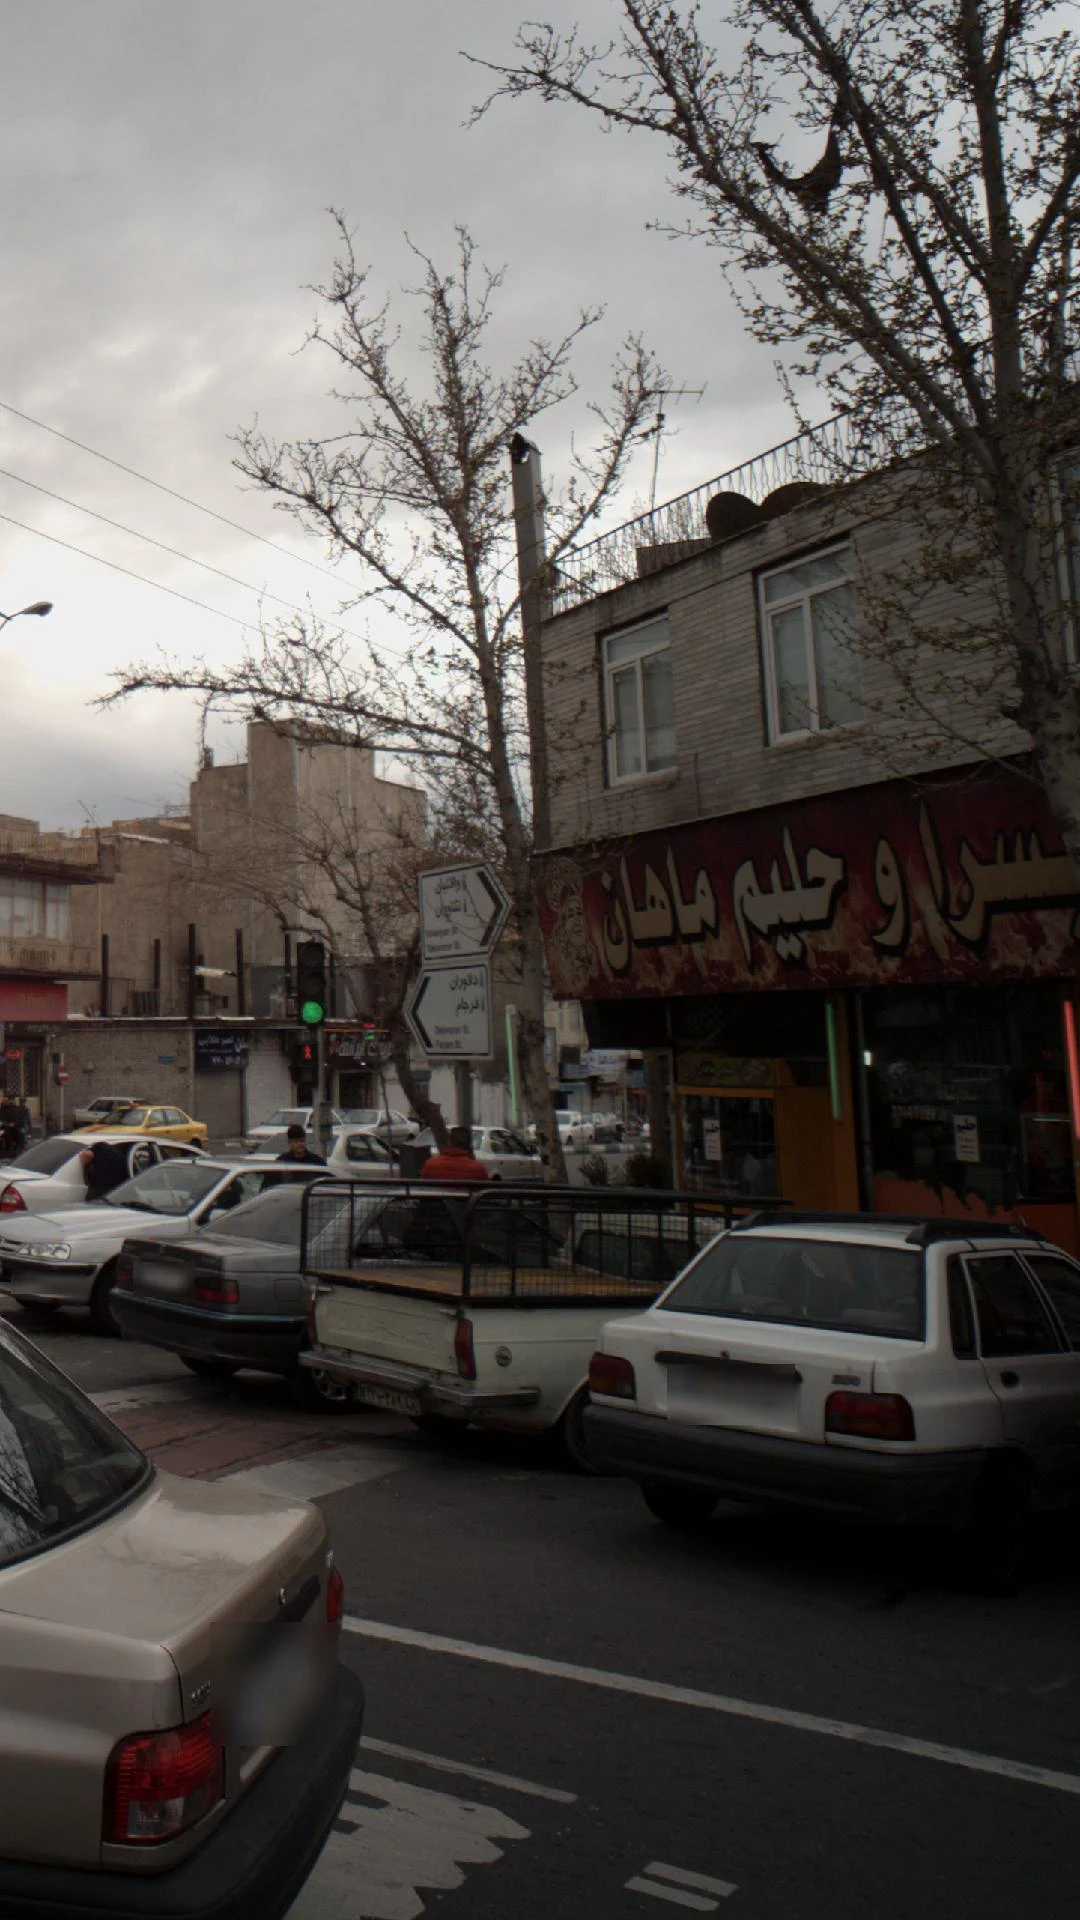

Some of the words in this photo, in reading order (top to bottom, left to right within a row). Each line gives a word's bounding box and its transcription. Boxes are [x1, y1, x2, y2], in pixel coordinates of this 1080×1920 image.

[602, 843, 717, 974] ماهان
[732, 824, 846, 973] حلیم
[872, 835, 906, 952] و
